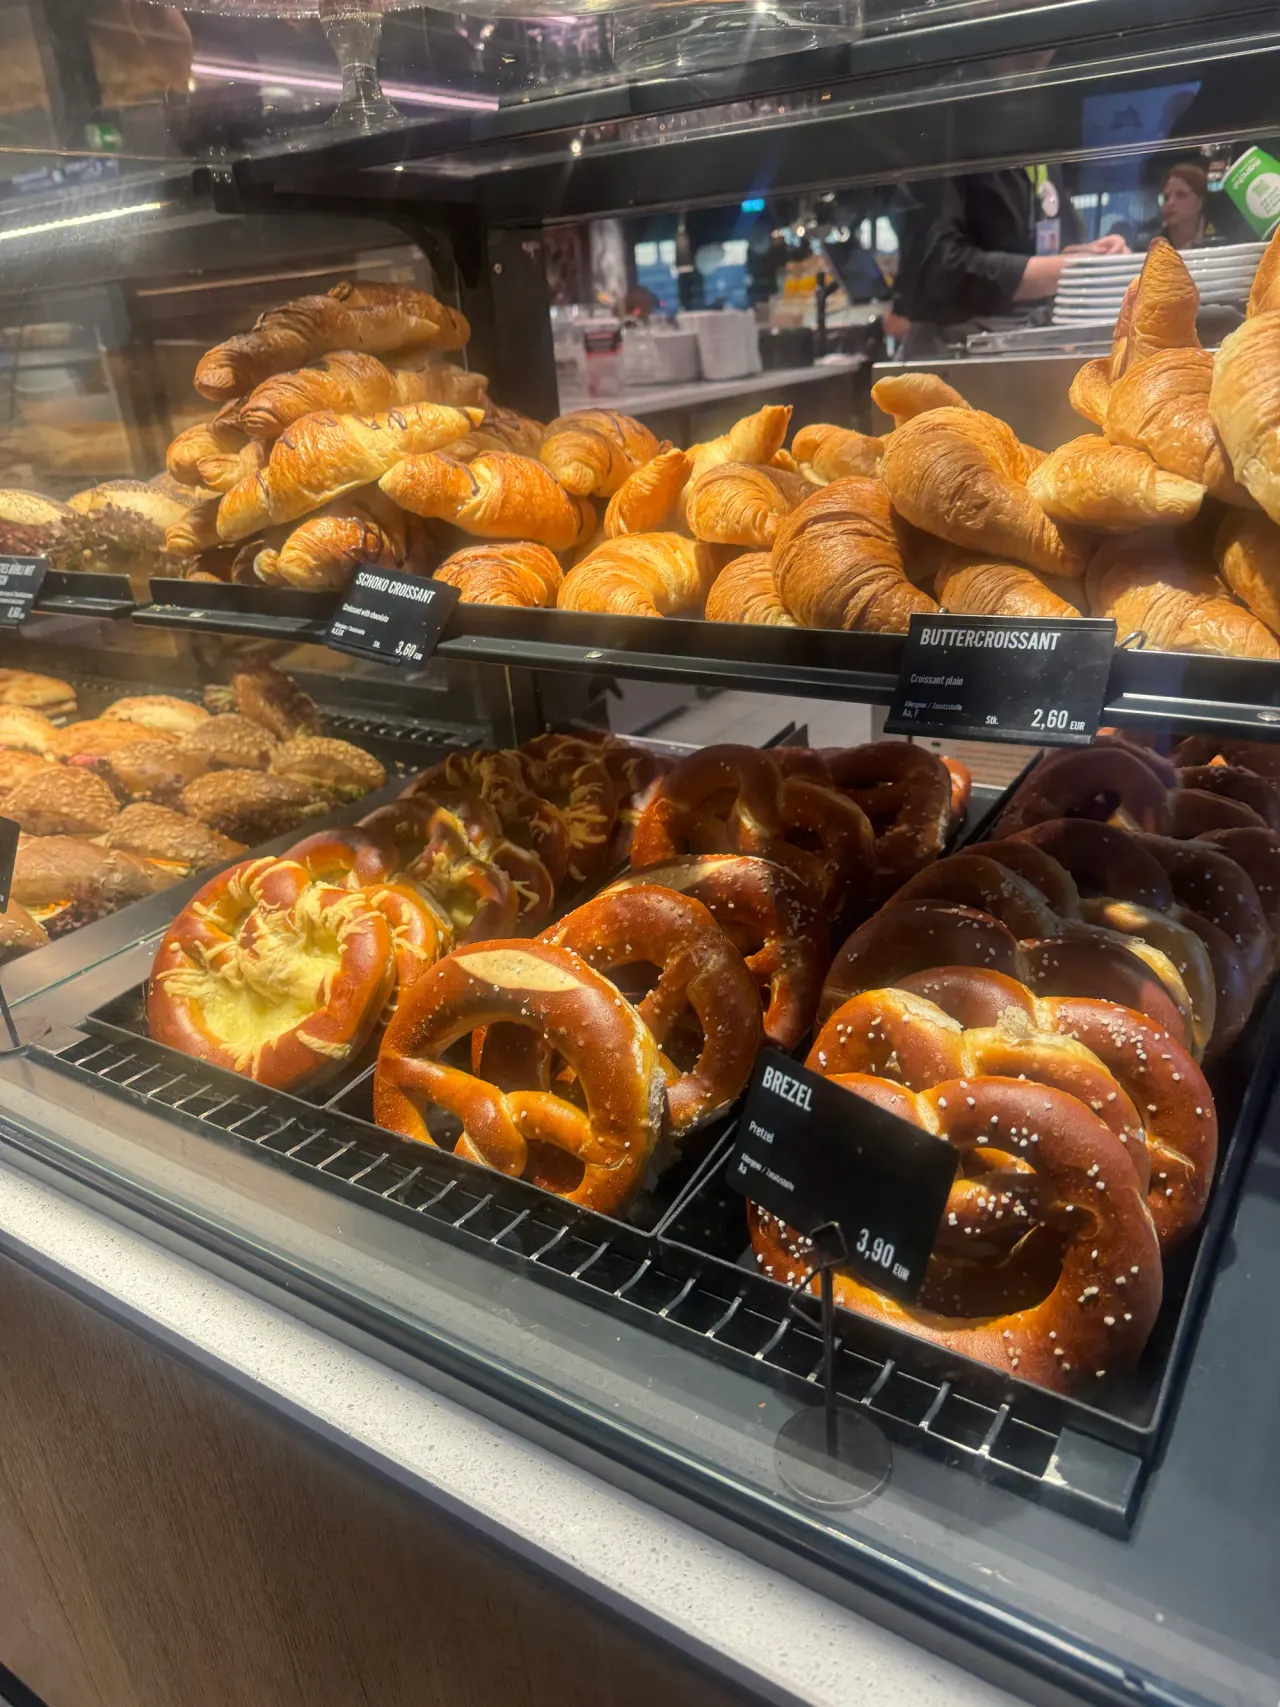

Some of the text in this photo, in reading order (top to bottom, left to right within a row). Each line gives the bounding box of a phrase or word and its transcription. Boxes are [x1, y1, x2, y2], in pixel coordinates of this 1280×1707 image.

[356, 572, 436, 604] SCHOKO CROISSANT
[395, 641, 416, 657] 3,60
[920, 628, 1061, 651] BUTTERCROISSANT
[910, 674, 964, 687] Croissant plain
[985, 715, 999, 725] Stk.
[1031, 709, 1086, 731] 2,60 EUR
[762, 1065, 813, 1112] BREZEL
[748, 1120, 775, 1145] Pretzel
[856, 1228, 911, 1282] 3,90 EUR
